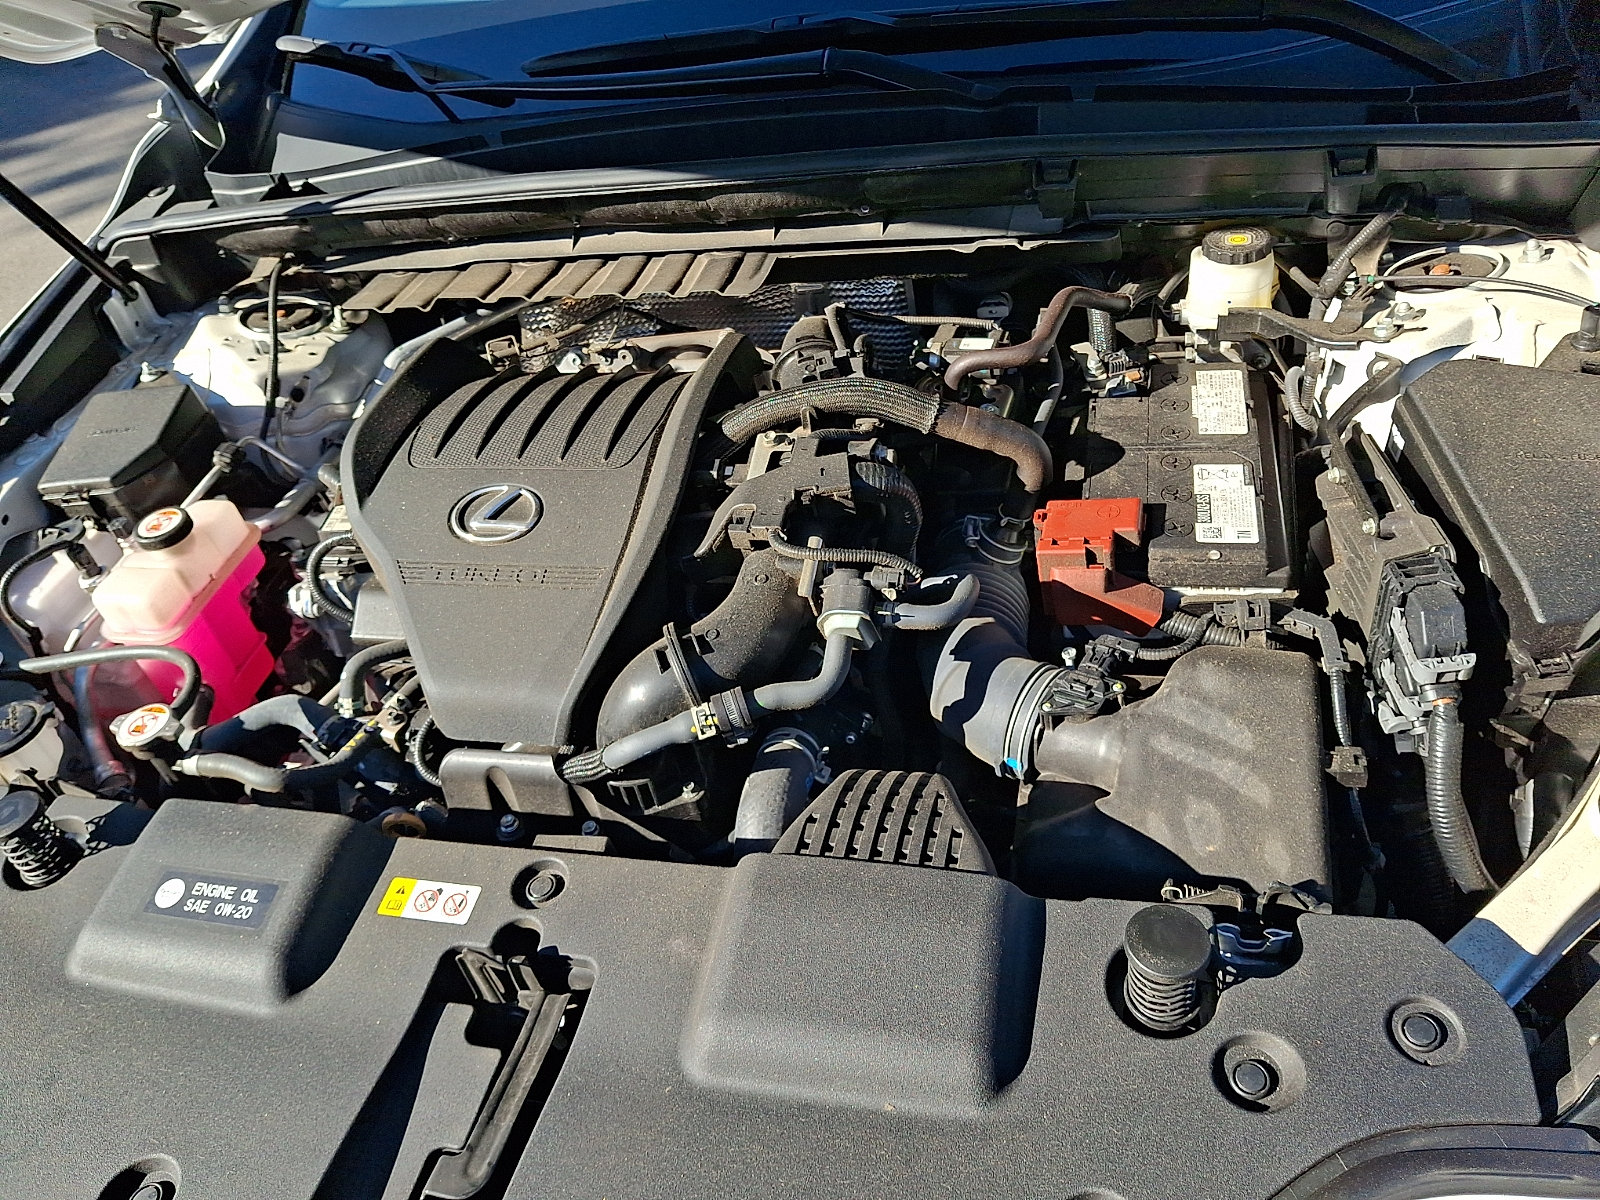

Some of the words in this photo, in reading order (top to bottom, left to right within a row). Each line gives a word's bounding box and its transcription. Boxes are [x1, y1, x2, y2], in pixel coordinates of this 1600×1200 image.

[191, 881, 238, 900] ENGINE
[240, 888, 259, 904] OIL
[183, 898, 211, 914] SAE
[214, 902, 254, 920] 0W-20
